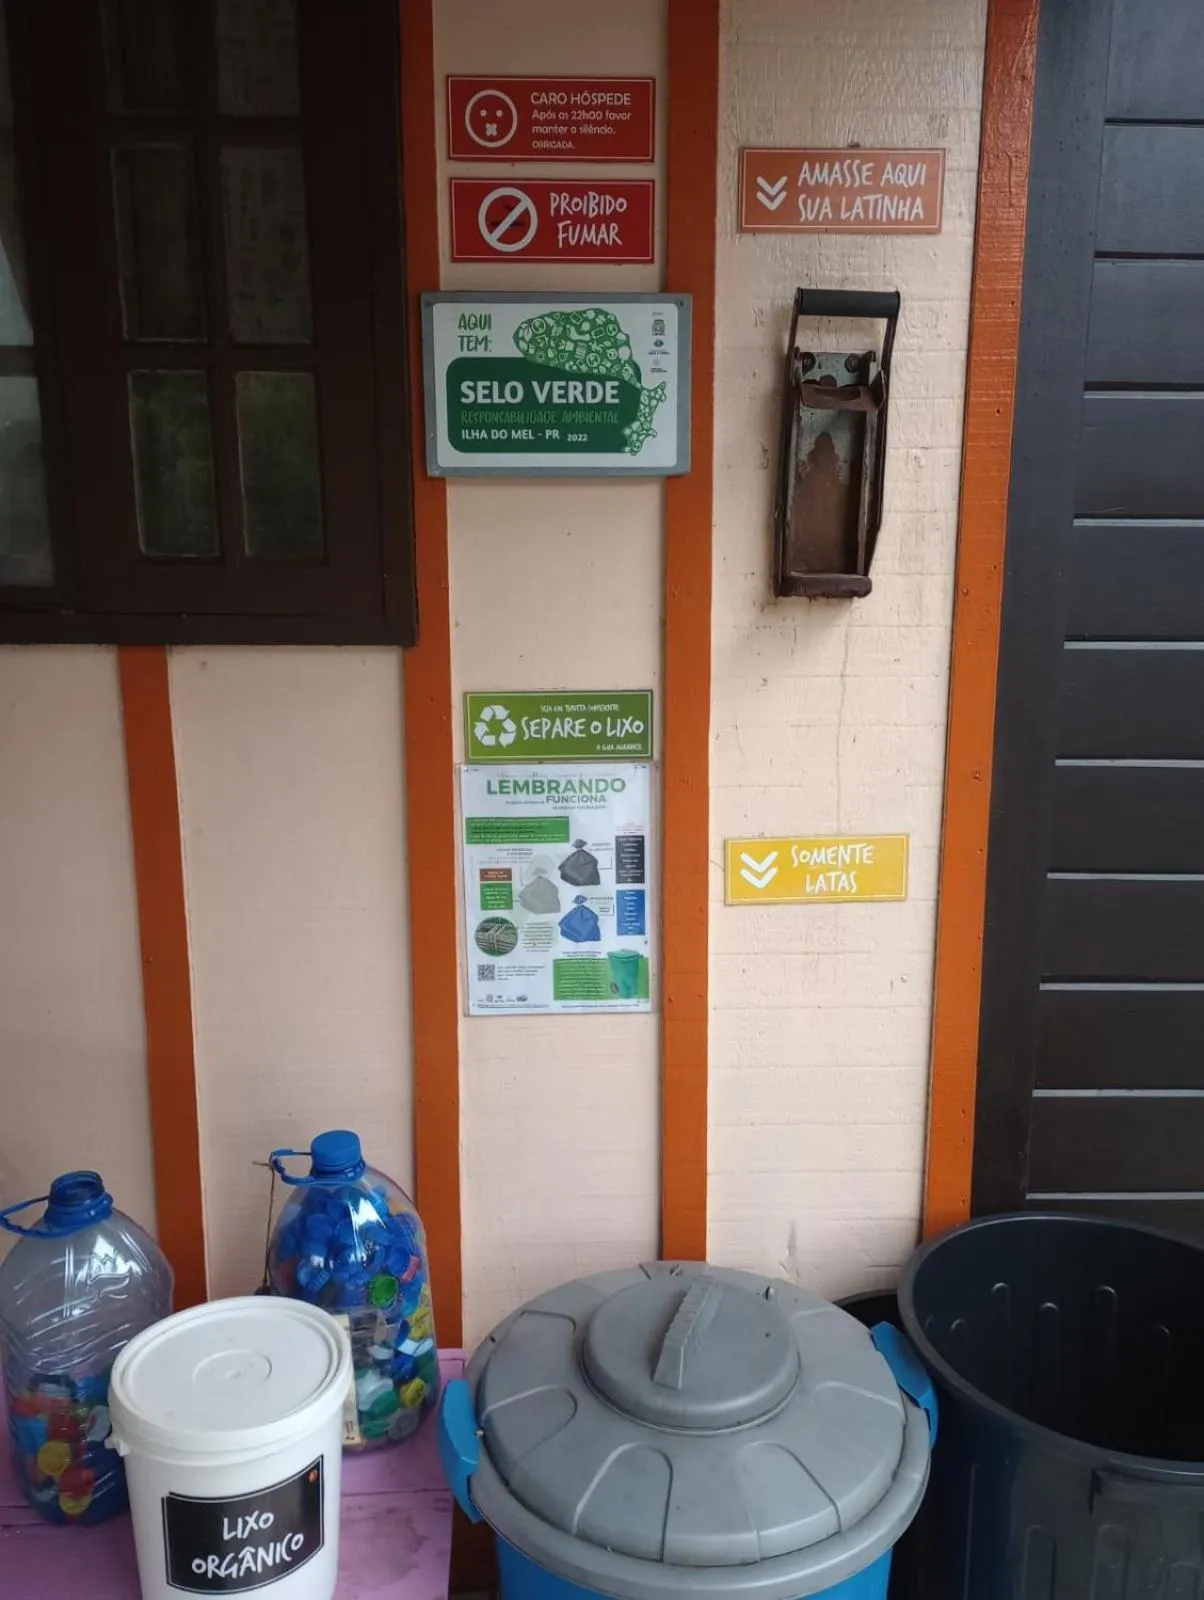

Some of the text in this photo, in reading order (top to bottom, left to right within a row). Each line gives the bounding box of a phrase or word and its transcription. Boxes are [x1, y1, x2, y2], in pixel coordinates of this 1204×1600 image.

[531, 90, 632, 106] CARO HÓSPEDE
[532, 109, 556, 121] Após
[571, 109, 603, 120] 22h00
[605, 110, 632, 120] favor
[532, 124, 616, 134] manter o silêncio.
[797, 159, 927, 188] AMASSE AQUI
[549, 191, 628, 218] PROIBIDO
[797, 193, 925, 222] SUA LATINHA
[557, 220, 623, 249] FUMAR
[457, 312, 492, 331] AQUI
[457, 335, 493, 353] TEM:
[460, 380, 620, 404] SELO VERDE
[461, 410, 619, 425] RESPONSABILIDADE AMBIENTAL
[461, 429, 488, 440] ILHA
[491, 429, 508, 440] DO
[511, 429, 535, 440] MEL
[545, 429, 560, 440] PR
[567, 433, 588, 442] 2022
[520, 716, 587, 740] SEPARE
[606, 715, 645, 738] LIXO
[486, 777, 626, 796] LEMBRANDO
[545, 794, 607, 805] FUNCIONA
[790, 842, 874, 869] SOMENTE
[805, 871, 858, 894] LATAS
[222, 1509, 274, 1542] LIXO
[192, 1532, 304, 1580] ORGÂNICO
